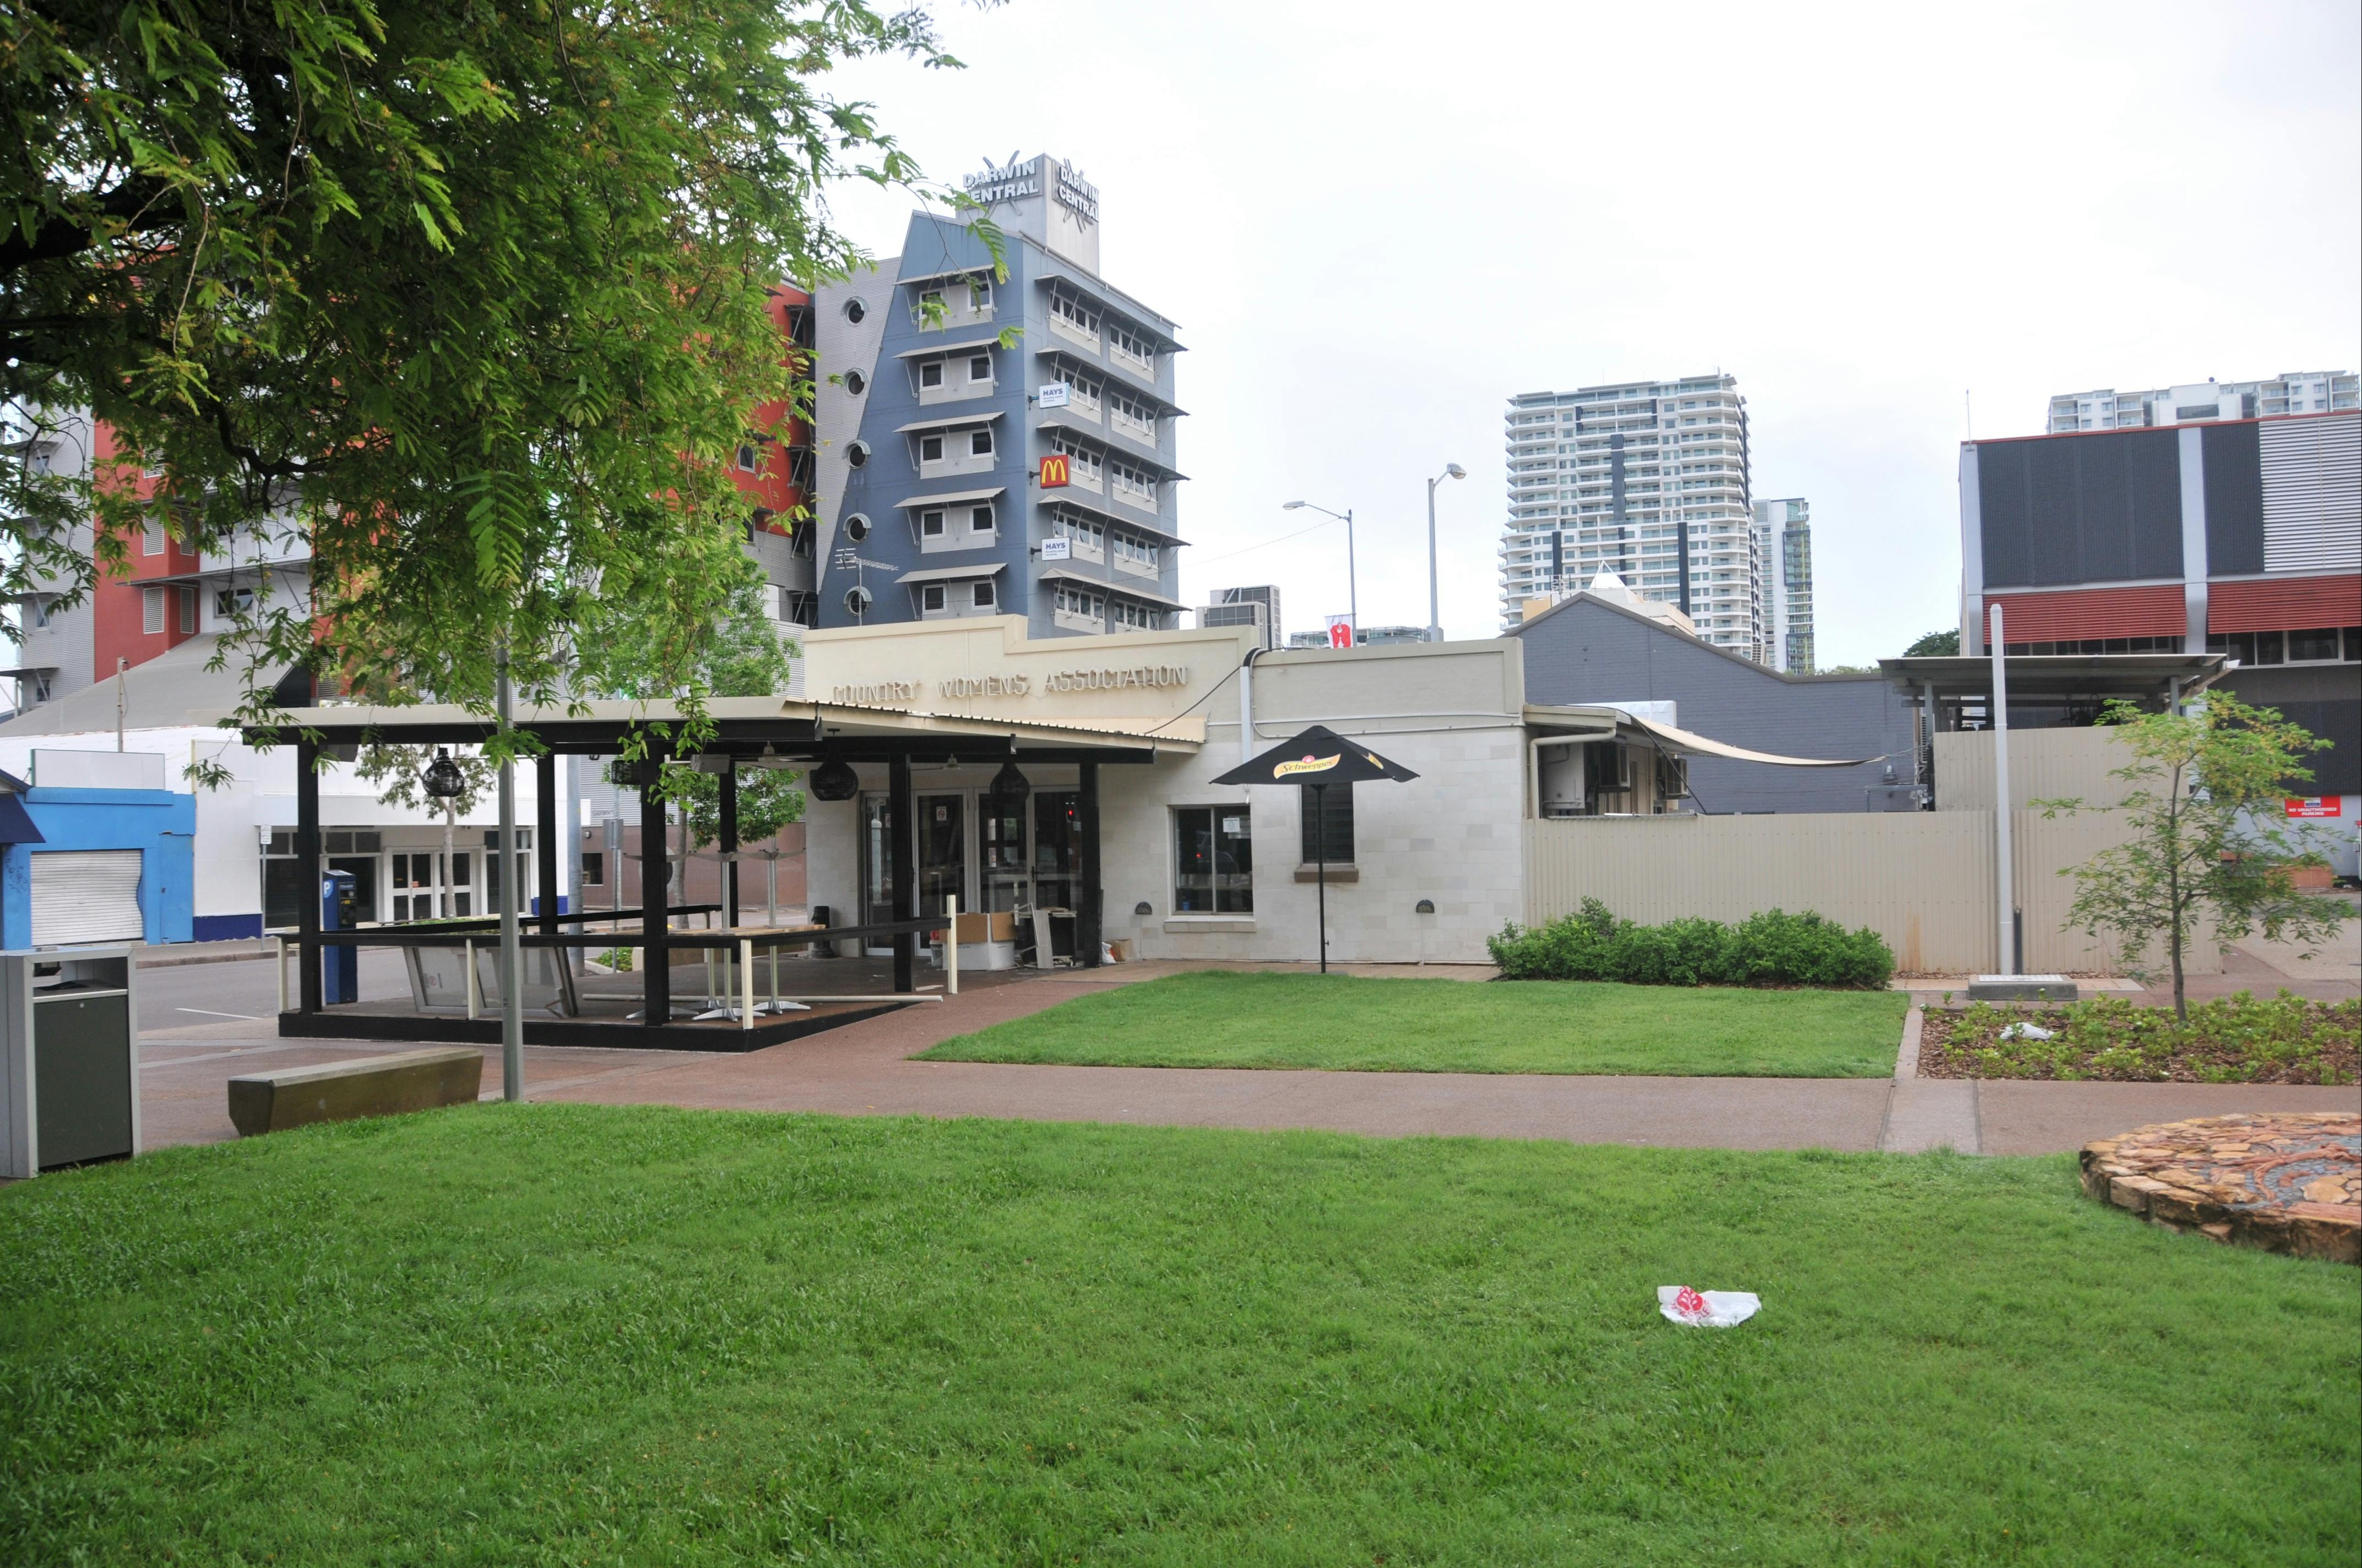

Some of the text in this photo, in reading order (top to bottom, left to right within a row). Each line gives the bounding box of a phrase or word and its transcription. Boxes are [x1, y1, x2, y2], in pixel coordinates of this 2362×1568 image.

[963, 160, 1036, 187] DARWIN
[1060, 166, 1098, 203] DARWIN
[964, 179, 1039, 204] ENTRAL
[1043, 388, 1063, 396] HAYS
[832, 665, 1187, 704] COUNTRY WOMENS ASSOCIATION
[1281, 760, 1332, 773] Schweppes
[323, 881, 330, 895] P
